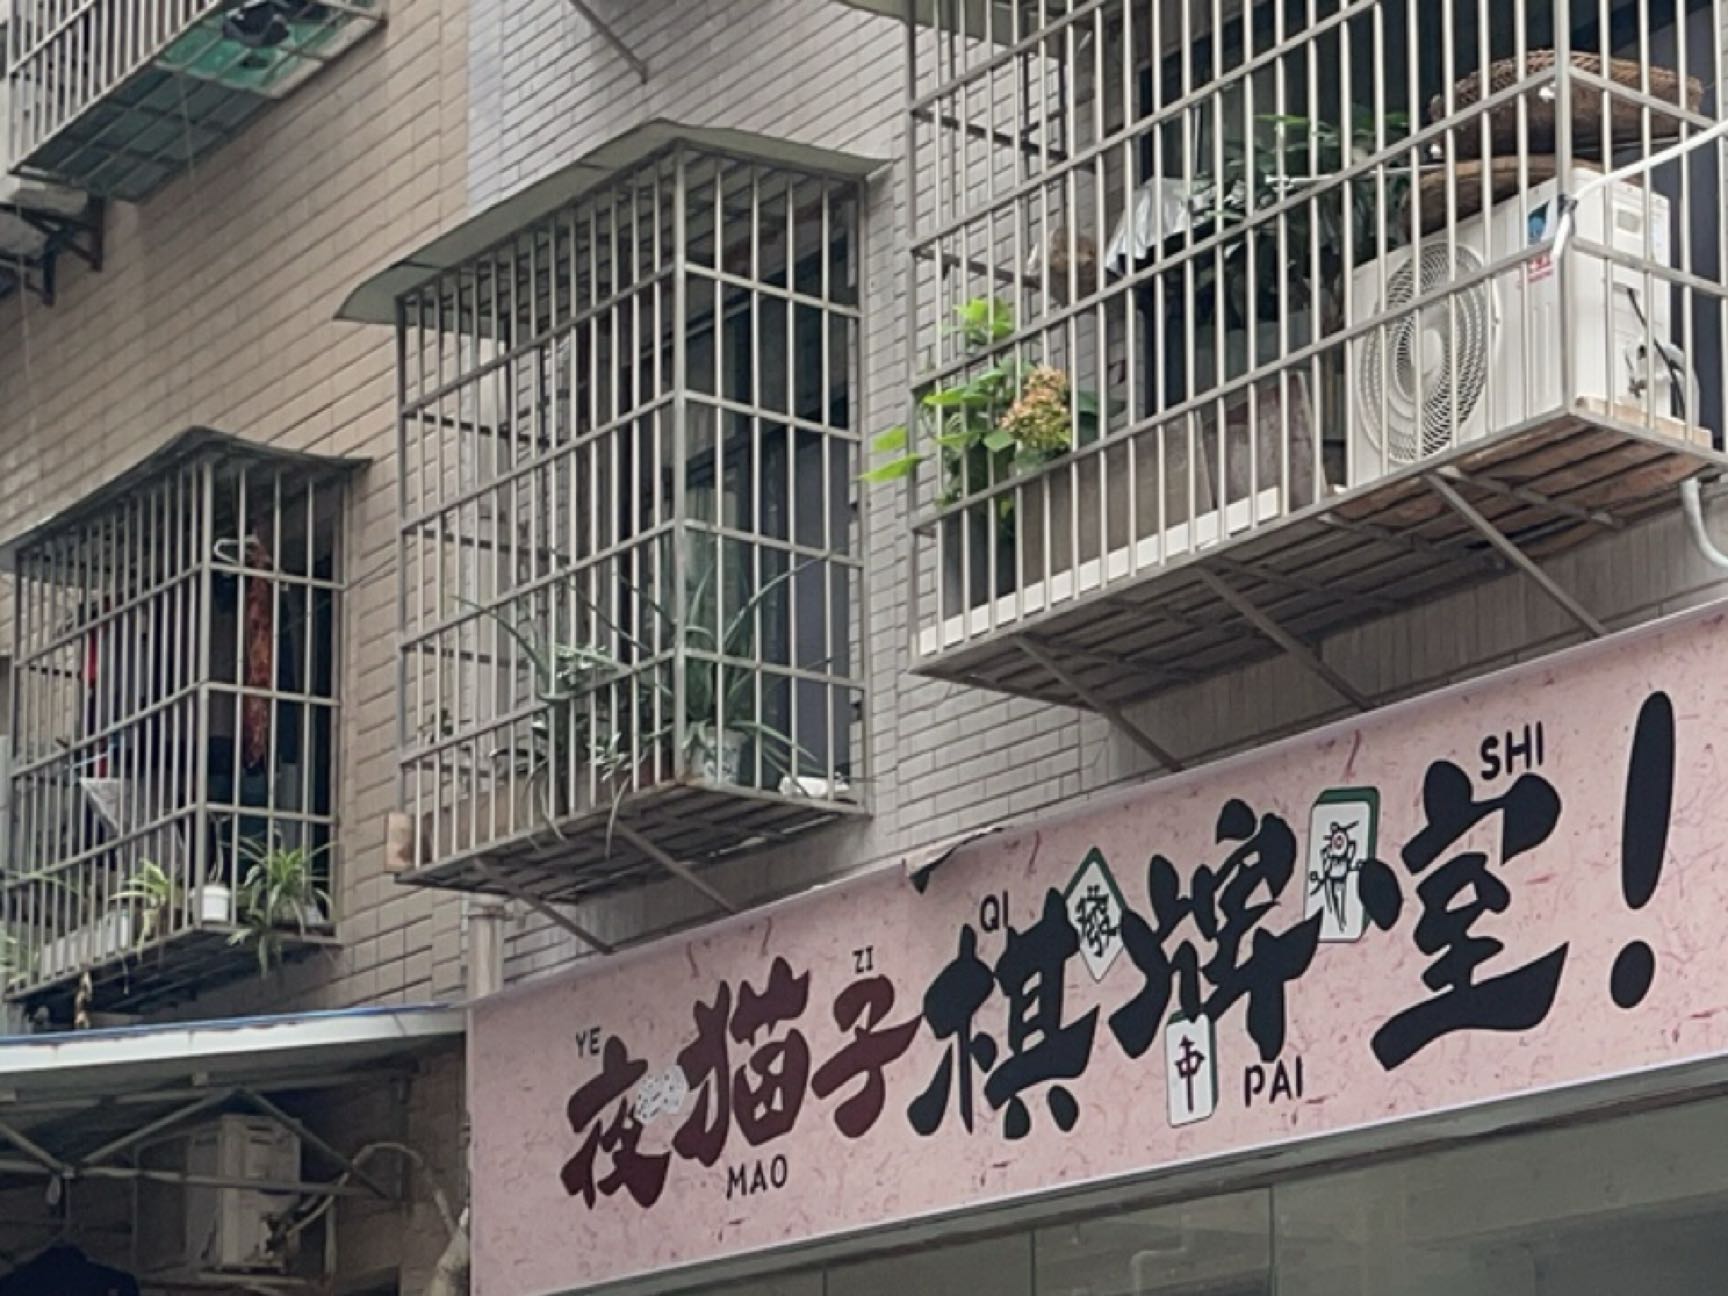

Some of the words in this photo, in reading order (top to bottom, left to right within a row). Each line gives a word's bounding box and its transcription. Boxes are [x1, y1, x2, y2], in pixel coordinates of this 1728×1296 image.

[1480, 721, 1544, 780] SHI
[979, 890, 1009, 932] QI
[851, 945, 874, 973] ZI
[575, 1027, 601, 1058] YE
[1175, 1036, 1204, 1112] 中
[1244, 1057, 1303, 1107] PAI
[726, 1154, 788, 1200] MAO
